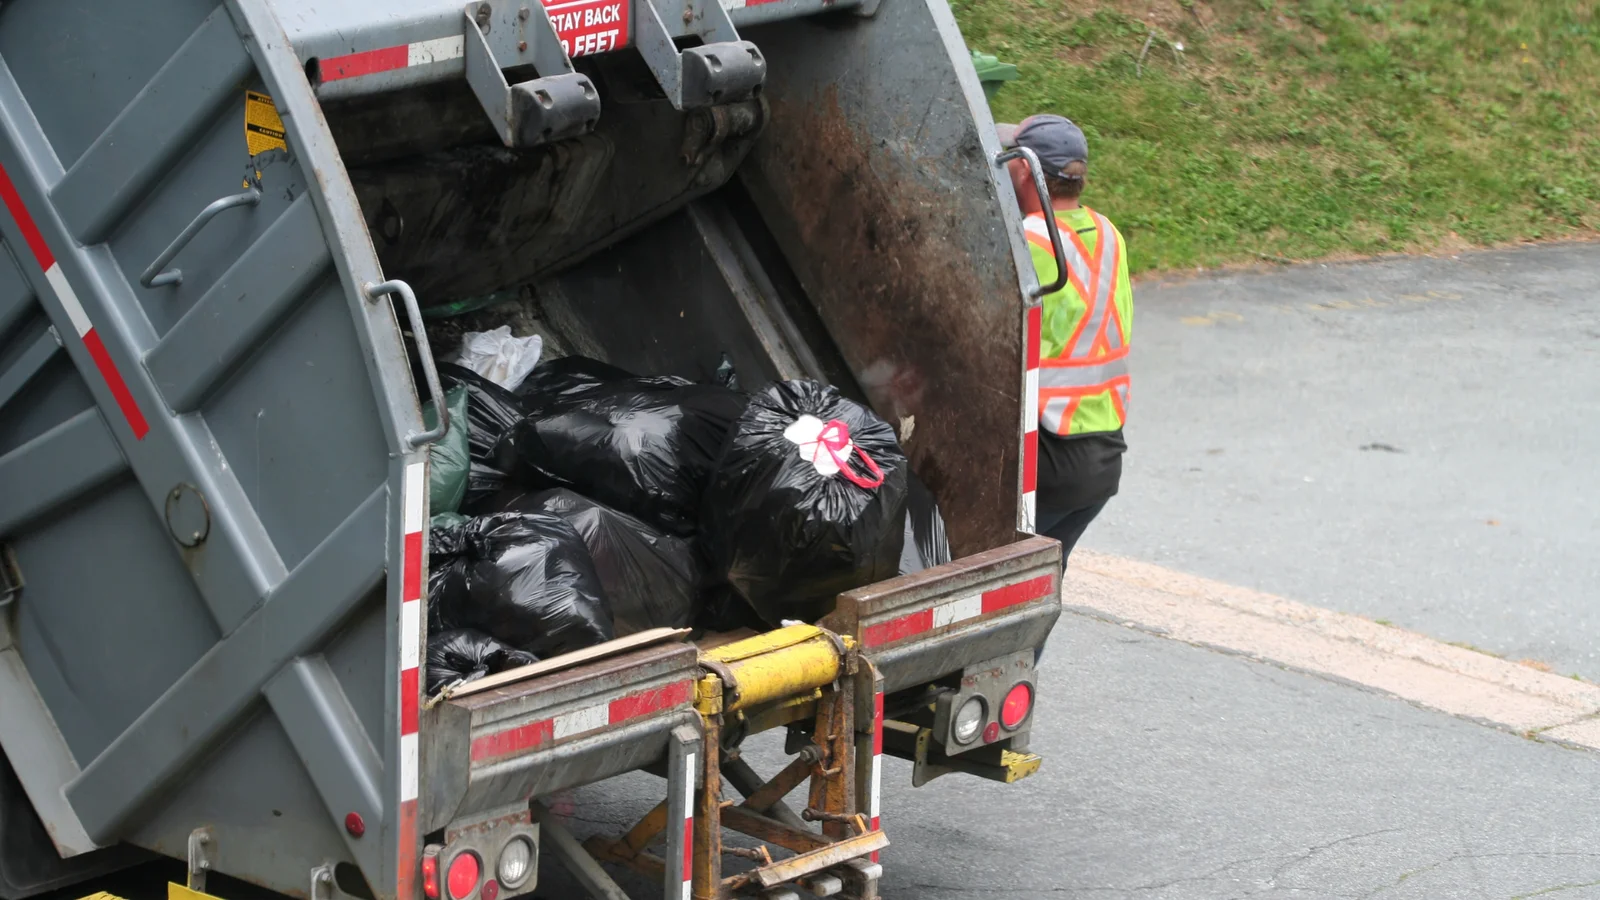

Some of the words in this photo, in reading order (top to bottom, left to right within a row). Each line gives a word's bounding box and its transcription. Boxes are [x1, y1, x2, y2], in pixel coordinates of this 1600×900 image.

[549, 11, 582, 32] STAY
[585, 3, 621, 27] BACK
[572, 29, 619, 58] FEET
